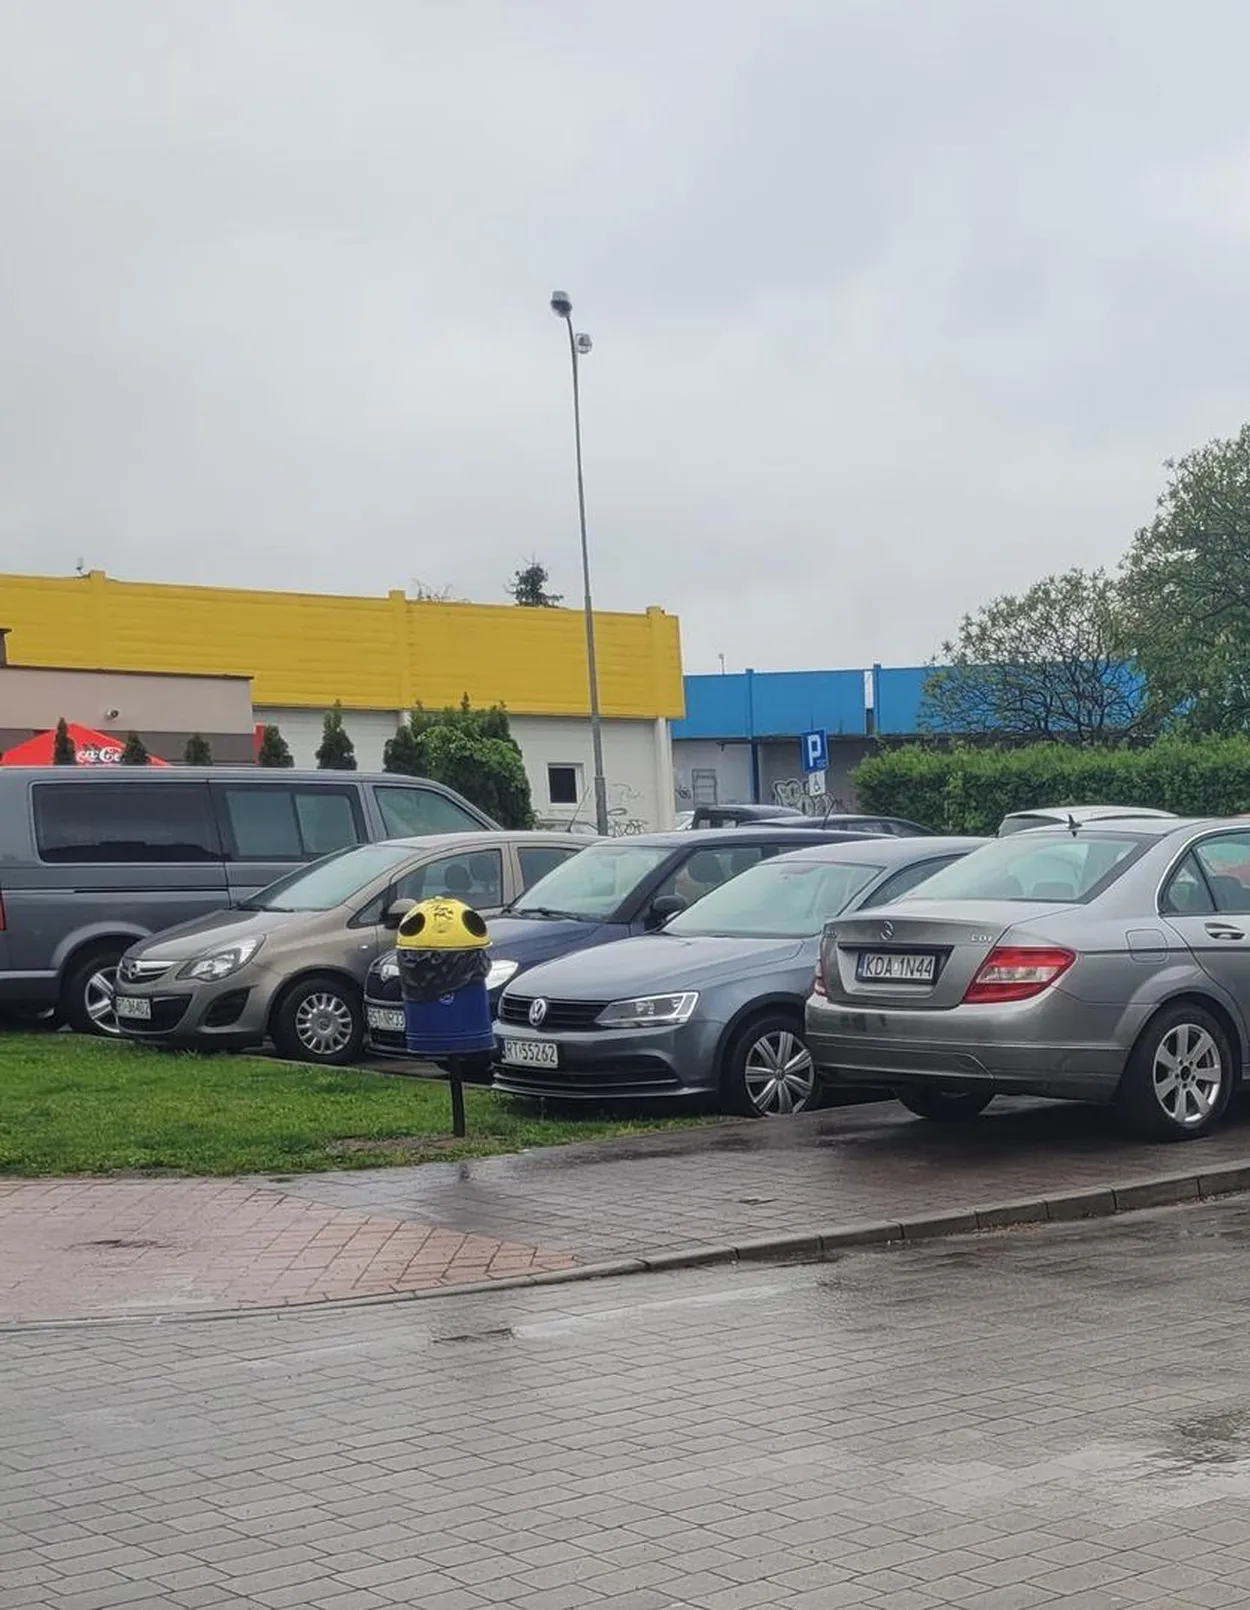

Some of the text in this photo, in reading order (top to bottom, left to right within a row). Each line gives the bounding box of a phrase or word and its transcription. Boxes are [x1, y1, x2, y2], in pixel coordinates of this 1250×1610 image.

[807, 734, 821, 767] P
[866, 956, 932, 977] KDA 1N44
[506, 1041, 556, 1063] RT 55262
